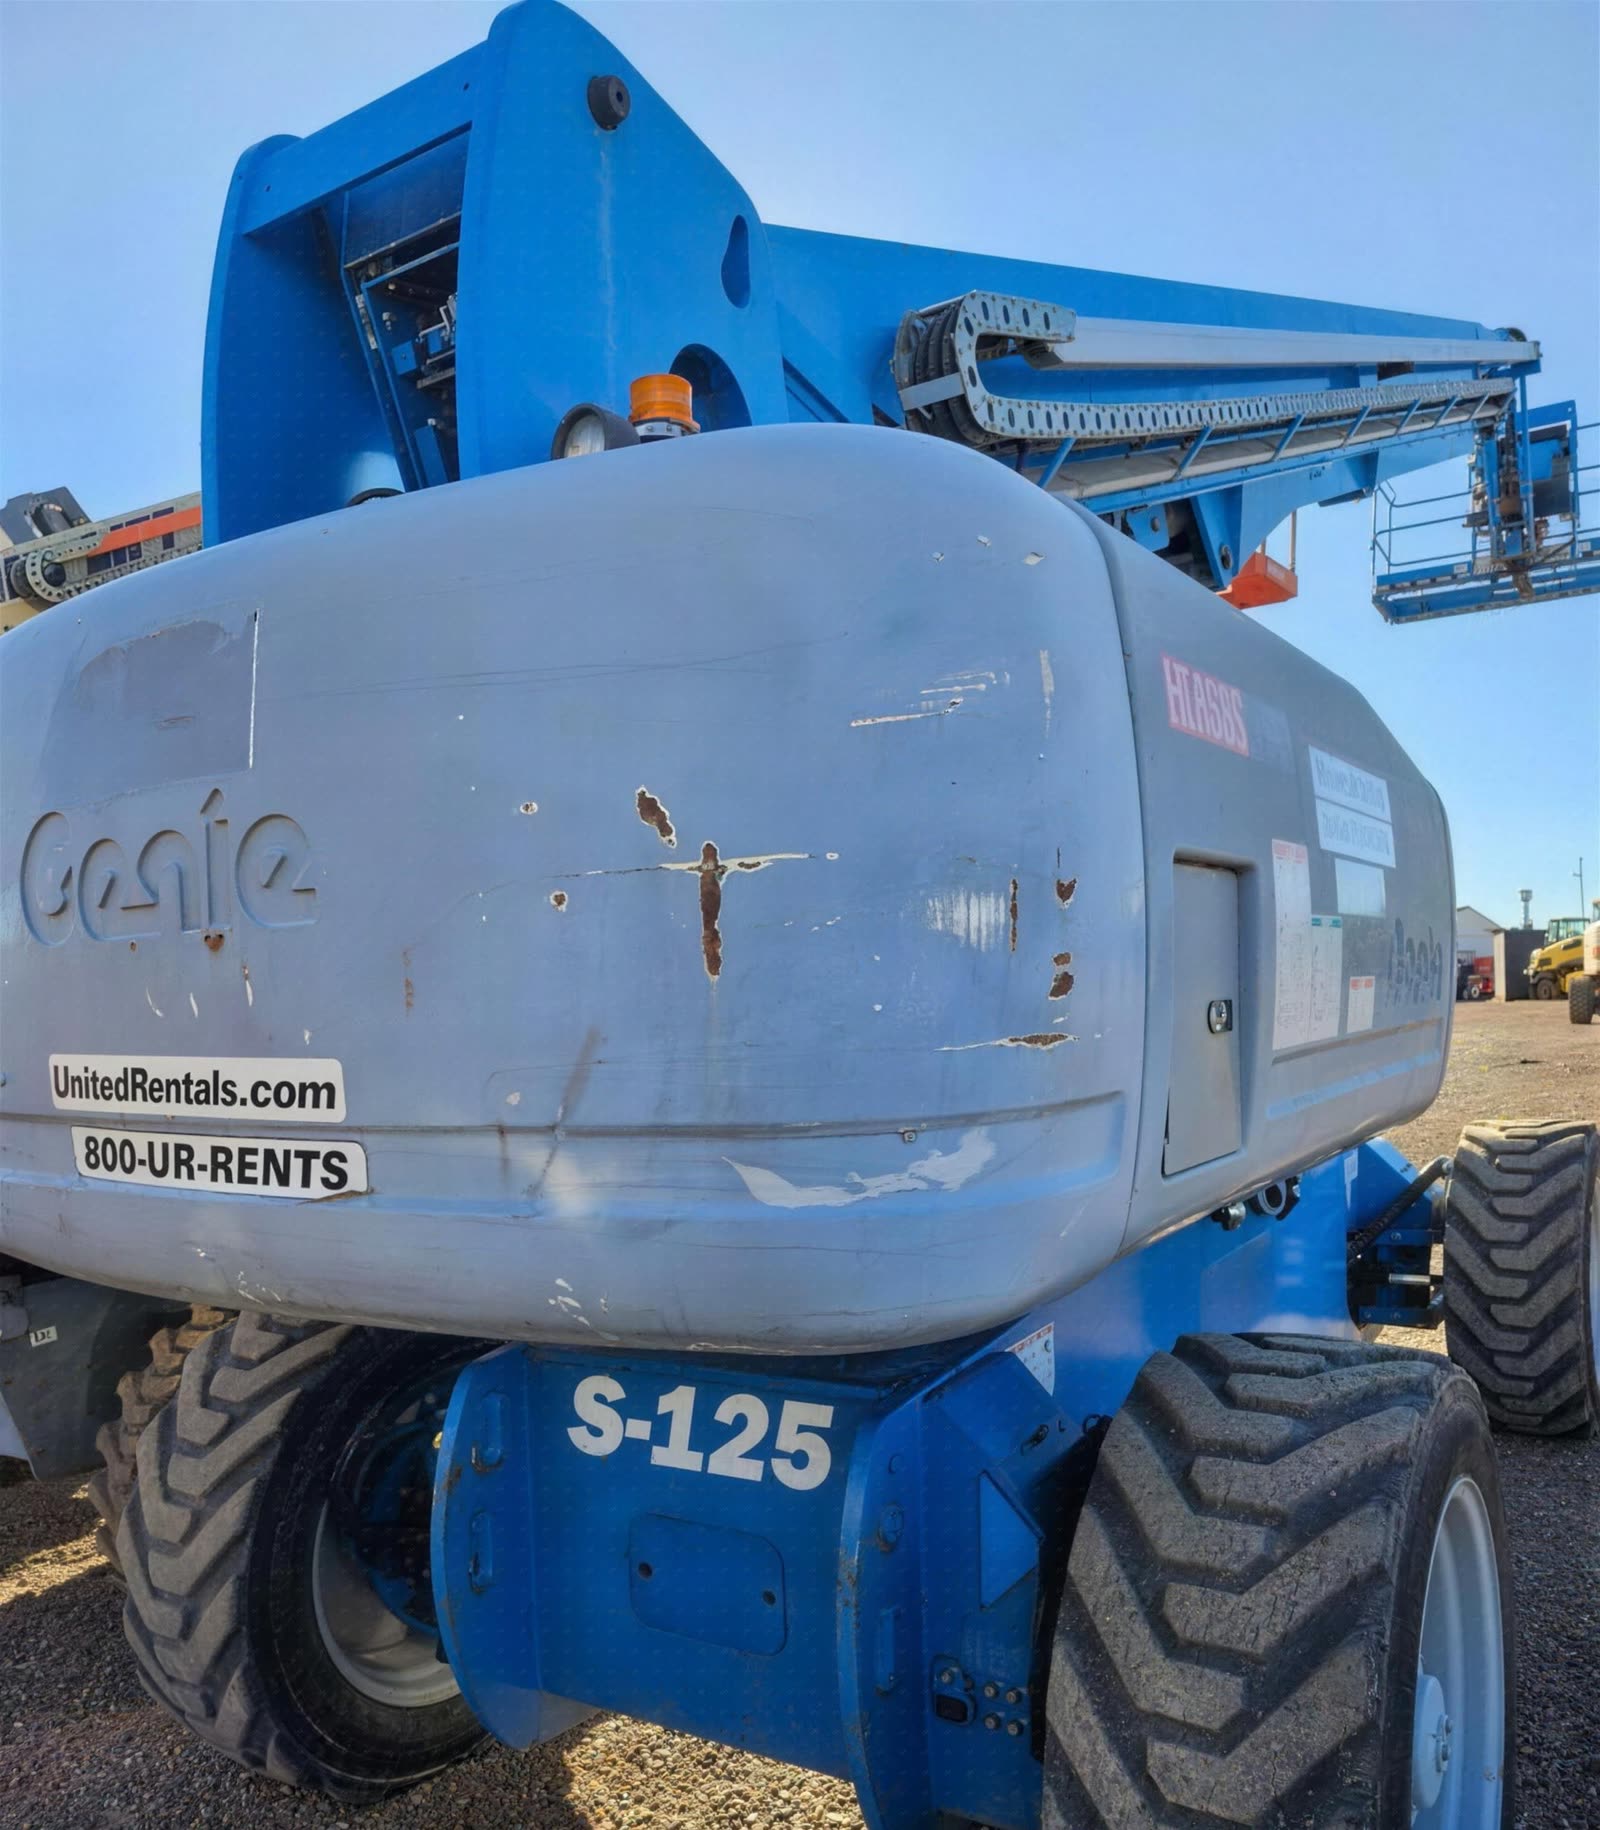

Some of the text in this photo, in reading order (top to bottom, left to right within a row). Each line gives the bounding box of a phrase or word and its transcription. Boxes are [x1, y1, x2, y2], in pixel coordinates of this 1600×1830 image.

[20, 788, 317, 947] Genie
[53, 1065, 336, 1110] UnitedRentals.com
[84, 1135, 349, 1190] 800-UR-RENTS
[567, 1375, 832, 1491] S-125
